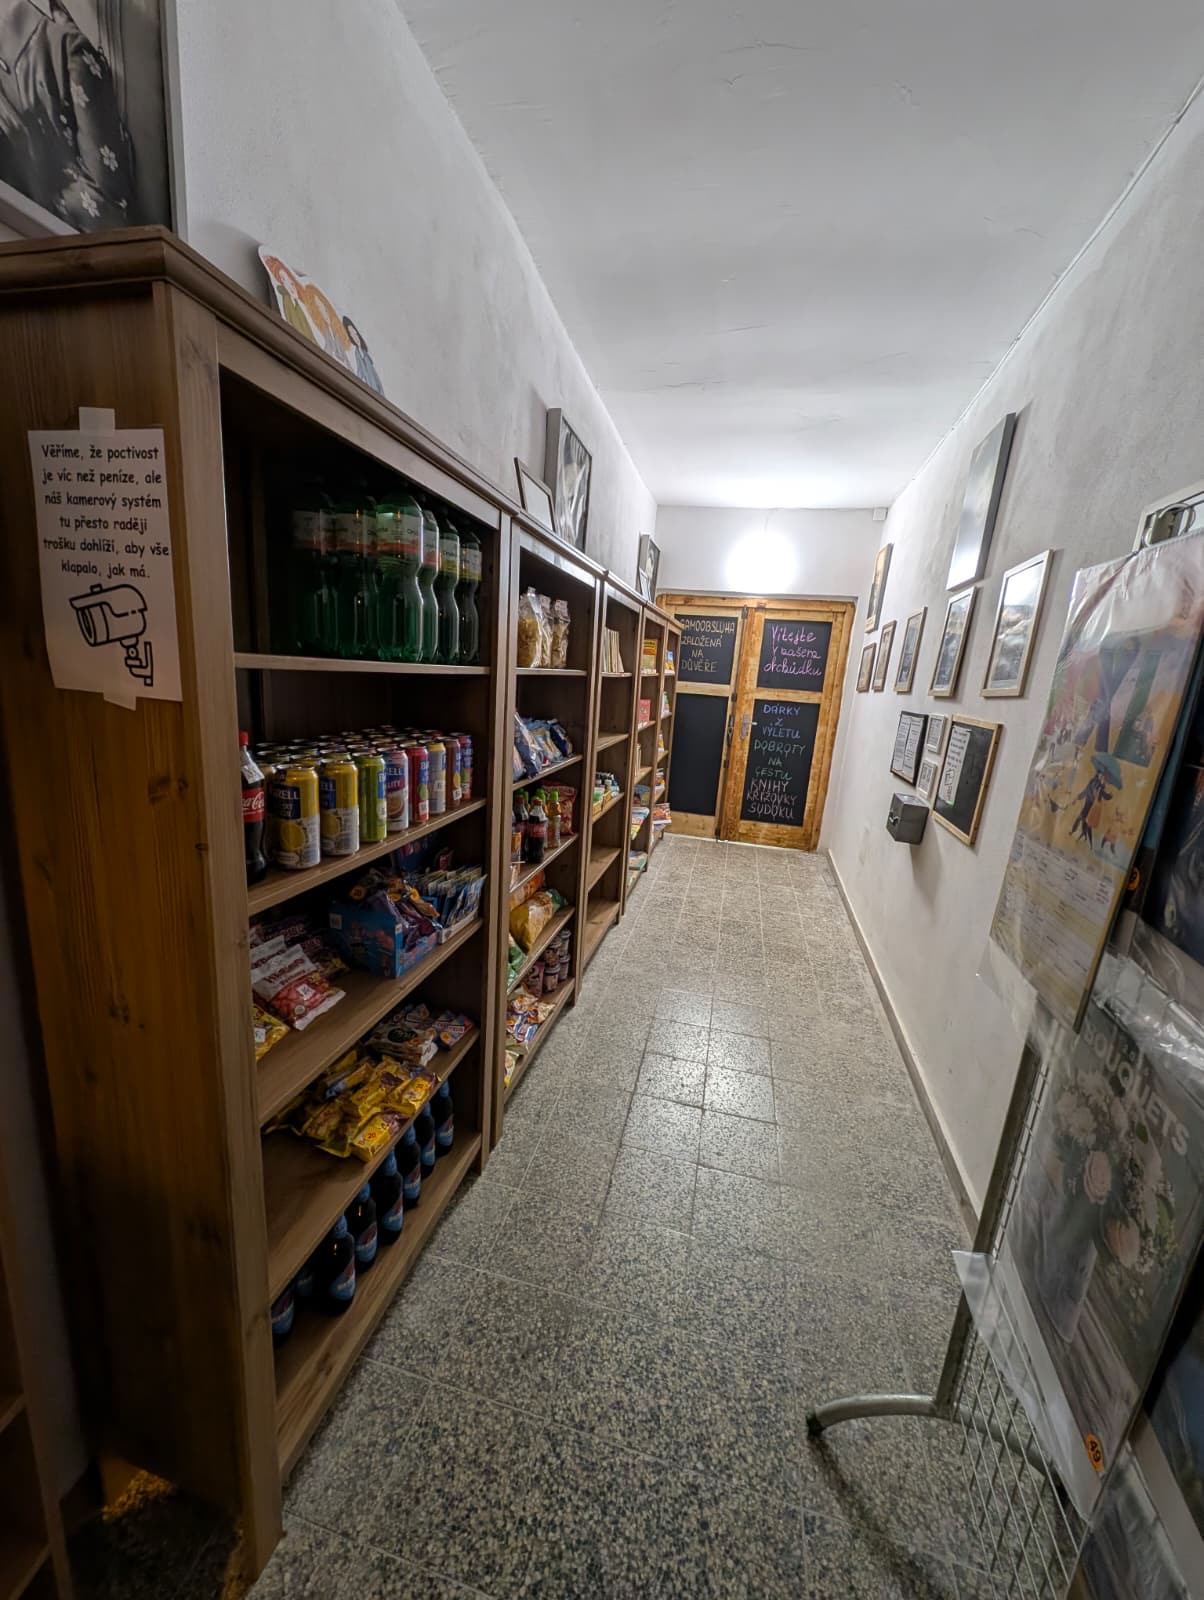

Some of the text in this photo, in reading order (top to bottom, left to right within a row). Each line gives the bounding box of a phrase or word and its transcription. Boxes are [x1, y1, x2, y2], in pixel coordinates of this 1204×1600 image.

[41, 444, 159, 462] Věříme, že poctivost
[42, 468, 162, 486] je víc než peníze, ale
[45, 491, 161, 510] náš kamerový systém
[59, 515, 148, 534] tu přesto raději
[43, 537, 75, 550] trošku
[125, 541, 145, 557] aby
[150, 542, 169, 556] vše
[61, 560, 150, 579] klapalo, jak má.
[691, 649, 704, 658] NA
[754, 739, 806, 756] DOBROTY
[768, 757, 783, 766] NA
[750, 778, 789, 792] KNIHY
[747, 802, 794, 819] SUDOKU
[1089, 1440, 1101, 1462] 49
